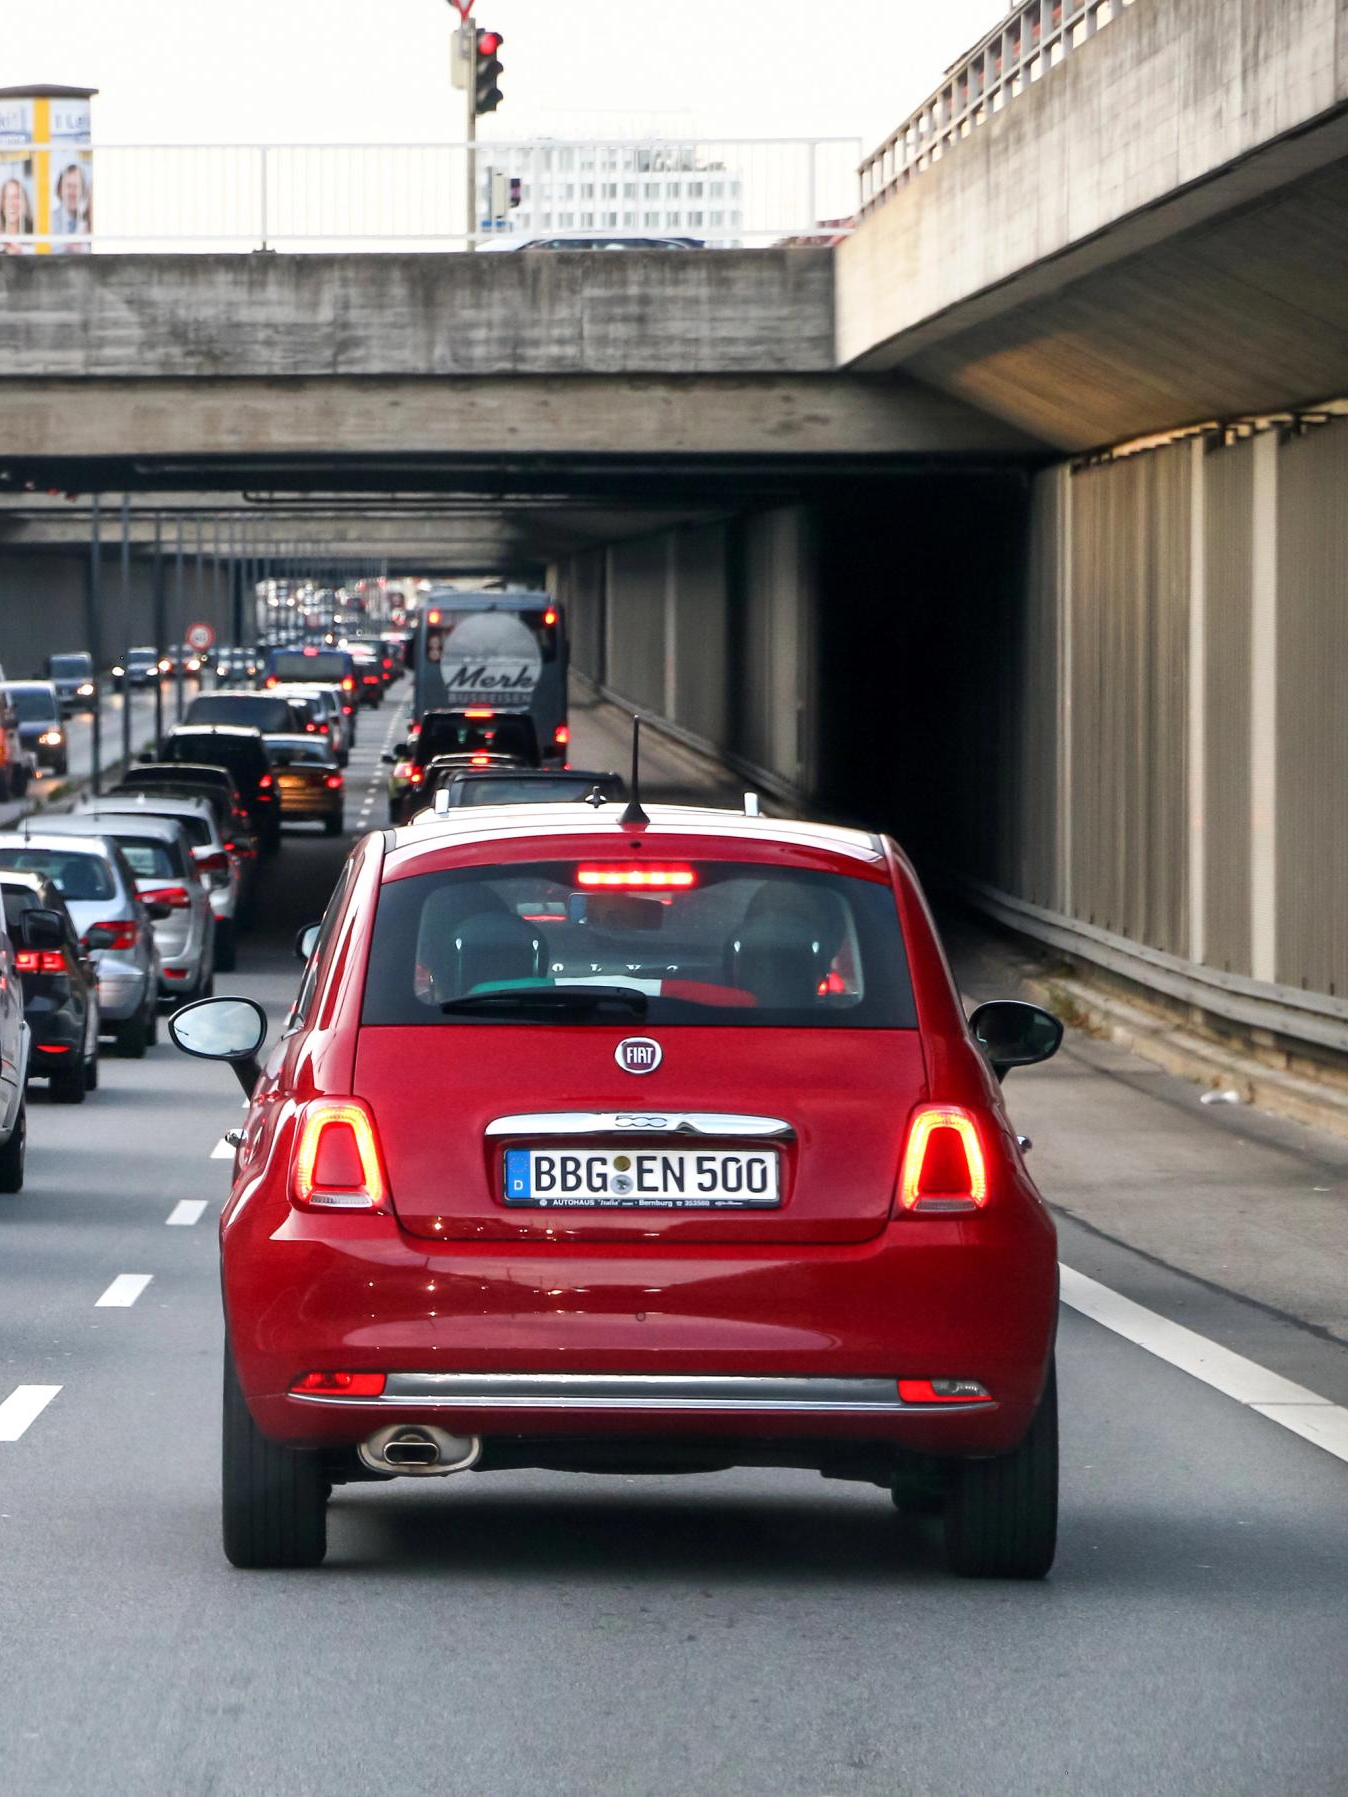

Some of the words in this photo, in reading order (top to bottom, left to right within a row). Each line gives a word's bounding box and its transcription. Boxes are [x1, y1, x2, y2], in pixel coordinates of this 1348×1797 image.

[446, 664, 537, 689] Merk
[626, 1047, 654, 1064] FIAT
[615, 1115, 668, 1128] 500
[534, 1156, 608, 1192] BBG
[636, 1156, 685, 1192] EN
[697, 1156, 768, 1193] 500
[514, 1180, 523, 1190] D
[639, 1199, 673, 1208] Bernburg
